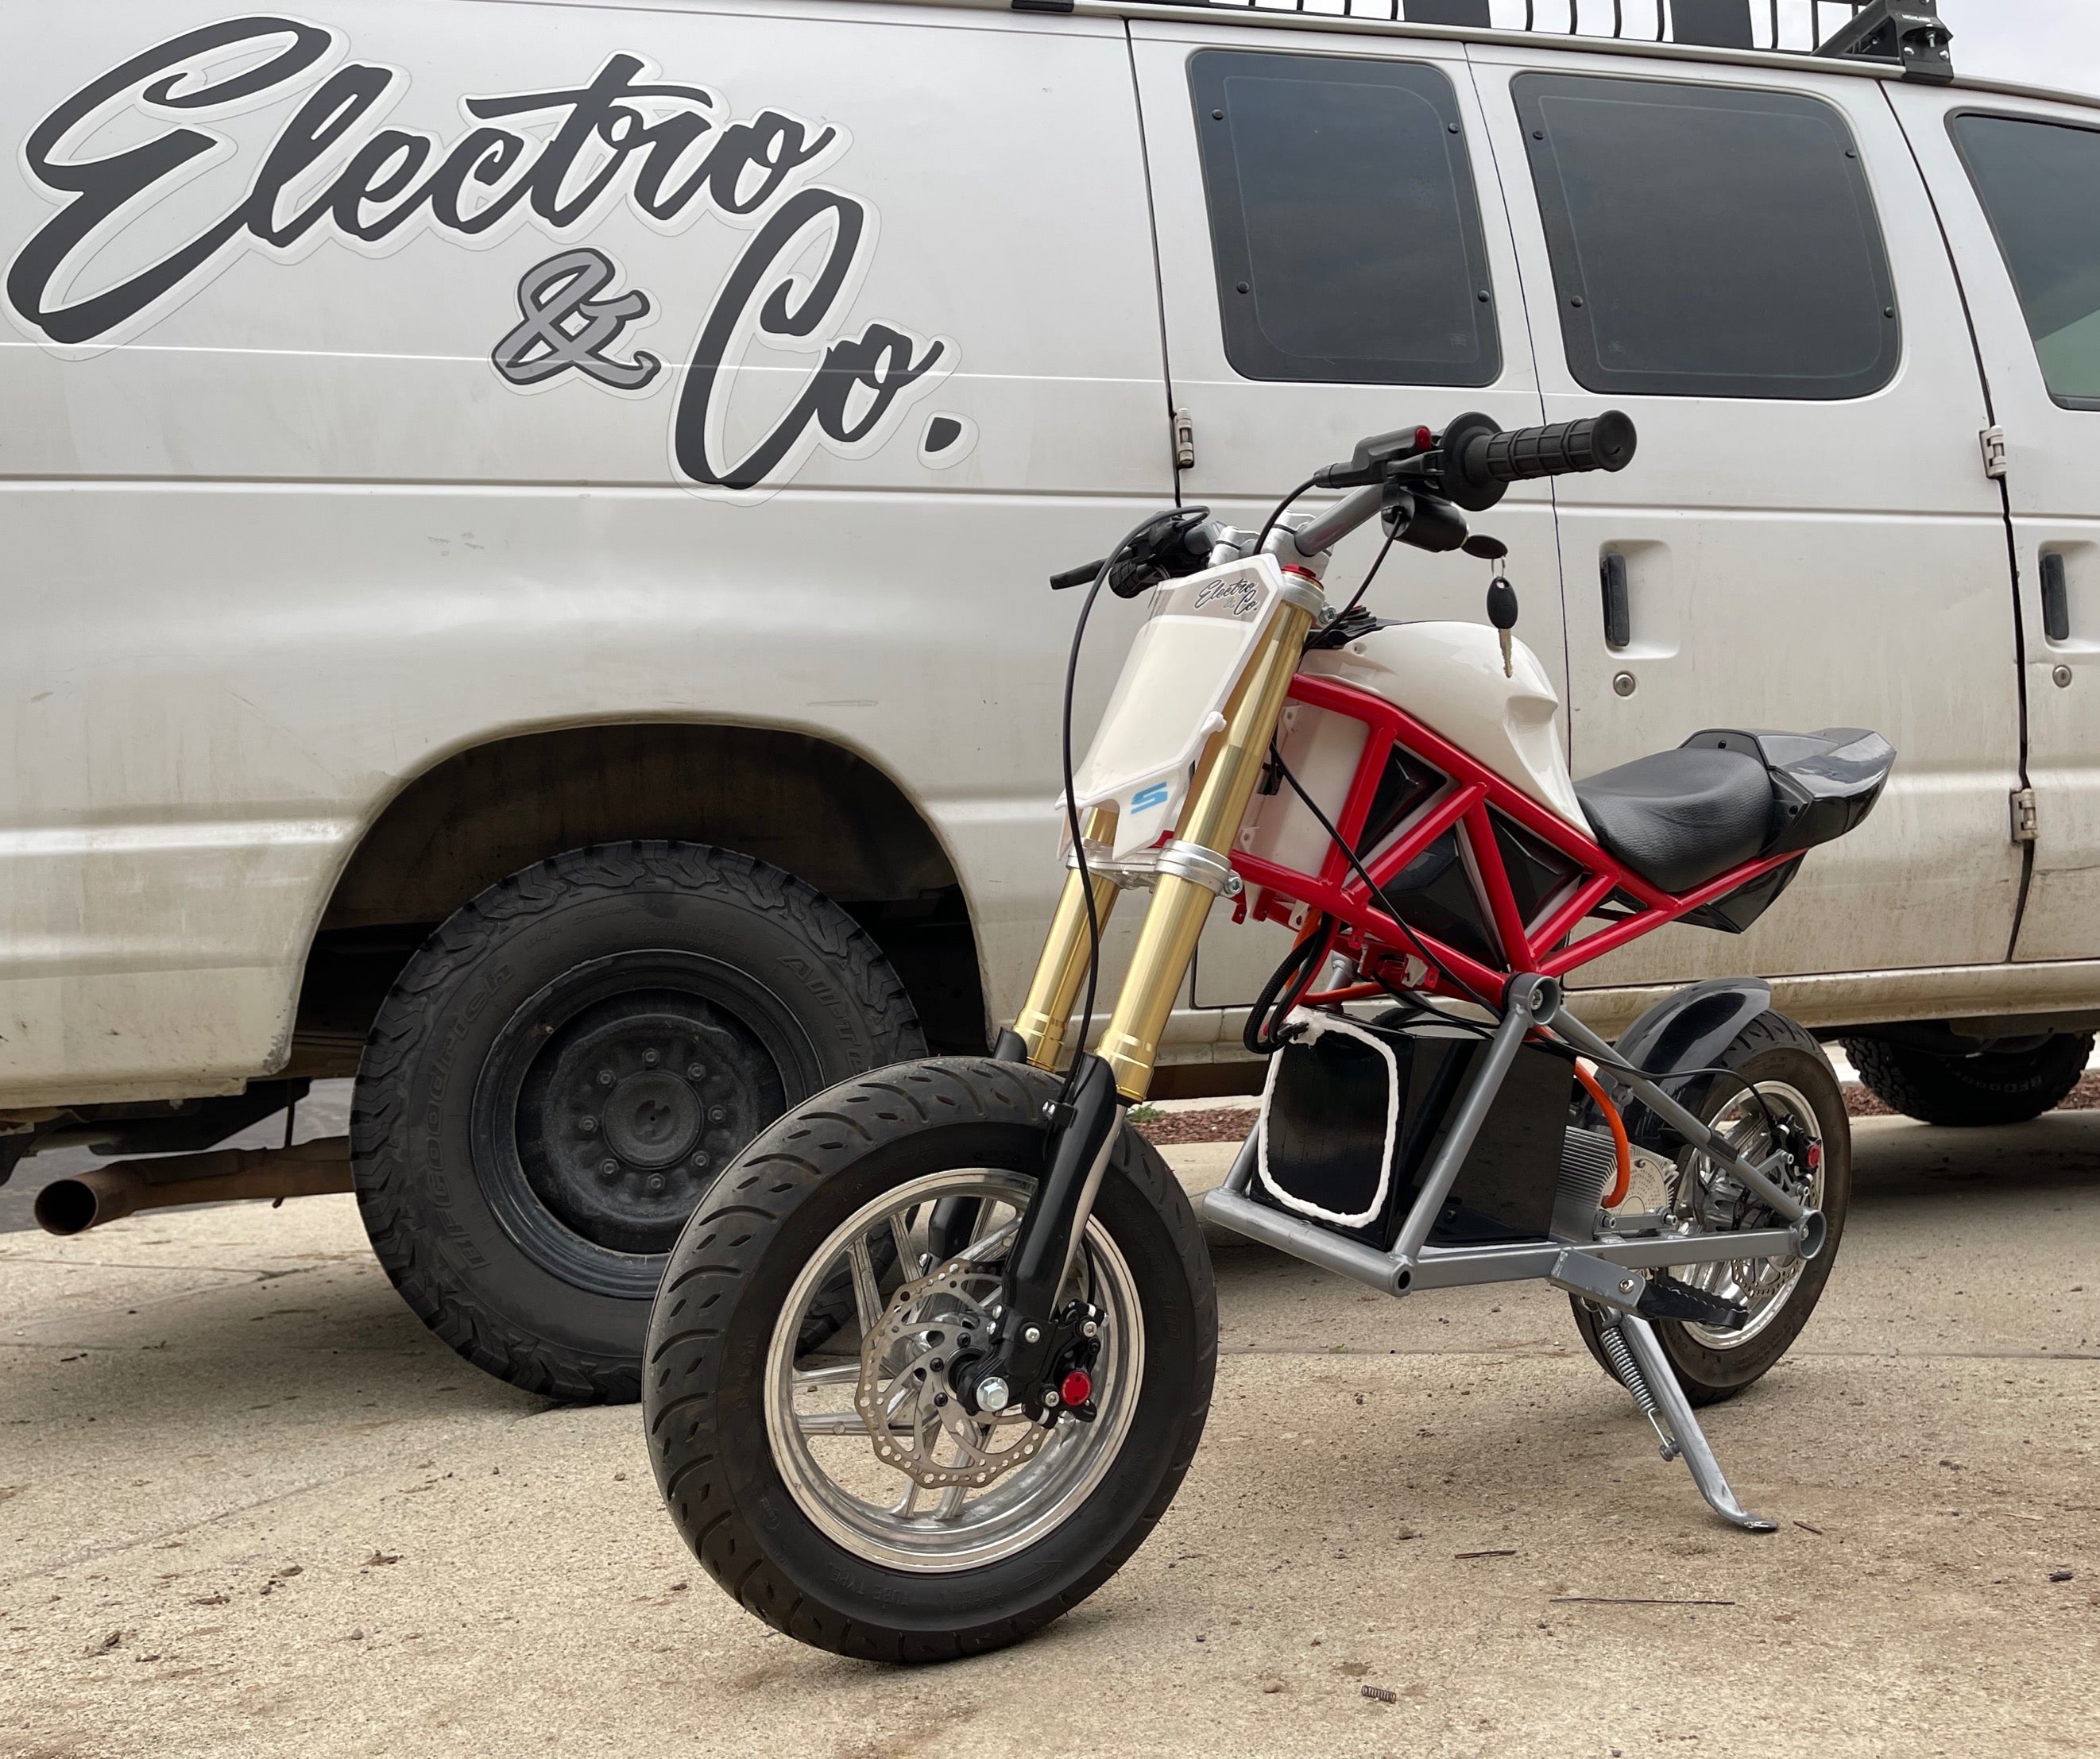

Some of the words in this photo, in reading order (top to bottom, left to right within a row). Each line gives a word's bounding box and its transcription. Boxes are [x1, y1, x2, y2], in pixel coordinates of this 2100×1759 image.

[6, 15, 833, 345] Electro
[490, 248, 662, 389] &
[675, 189, 963, 490] Co.
[1194, 578, 1257, 609] Electro
[1234, 590, 1258, 616] Co.
[426, 964, 516, 1269] BFGoodrich
